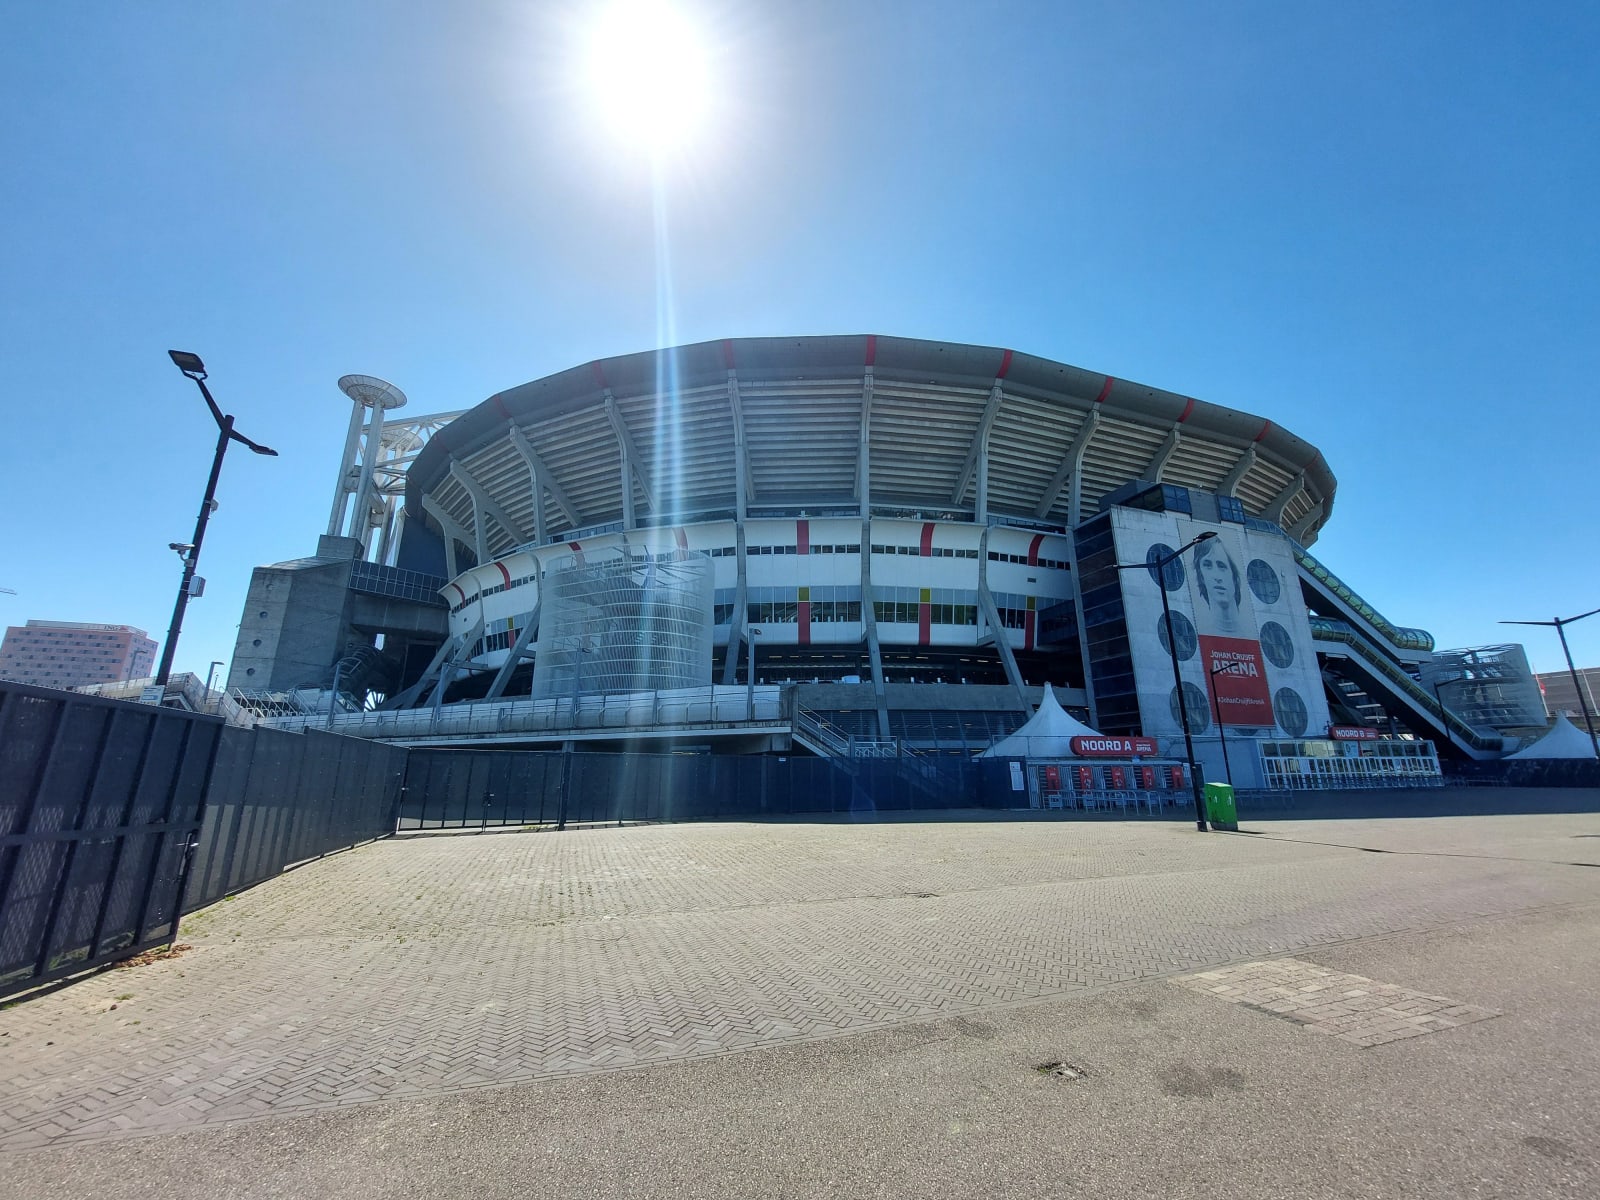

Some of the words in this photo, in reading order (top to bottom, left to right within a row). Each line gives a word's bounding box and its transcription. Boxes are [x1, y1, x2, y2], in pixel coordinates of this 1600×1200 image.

[1210, 650, 1232, 660] JOHAN
[1213, 660, 1258, 677] ARENA
[1335, 729, 1358, 738] NOORD
[1081, 740, 1122, 751] NOORD
[1124, 740, 1132, 751] A
